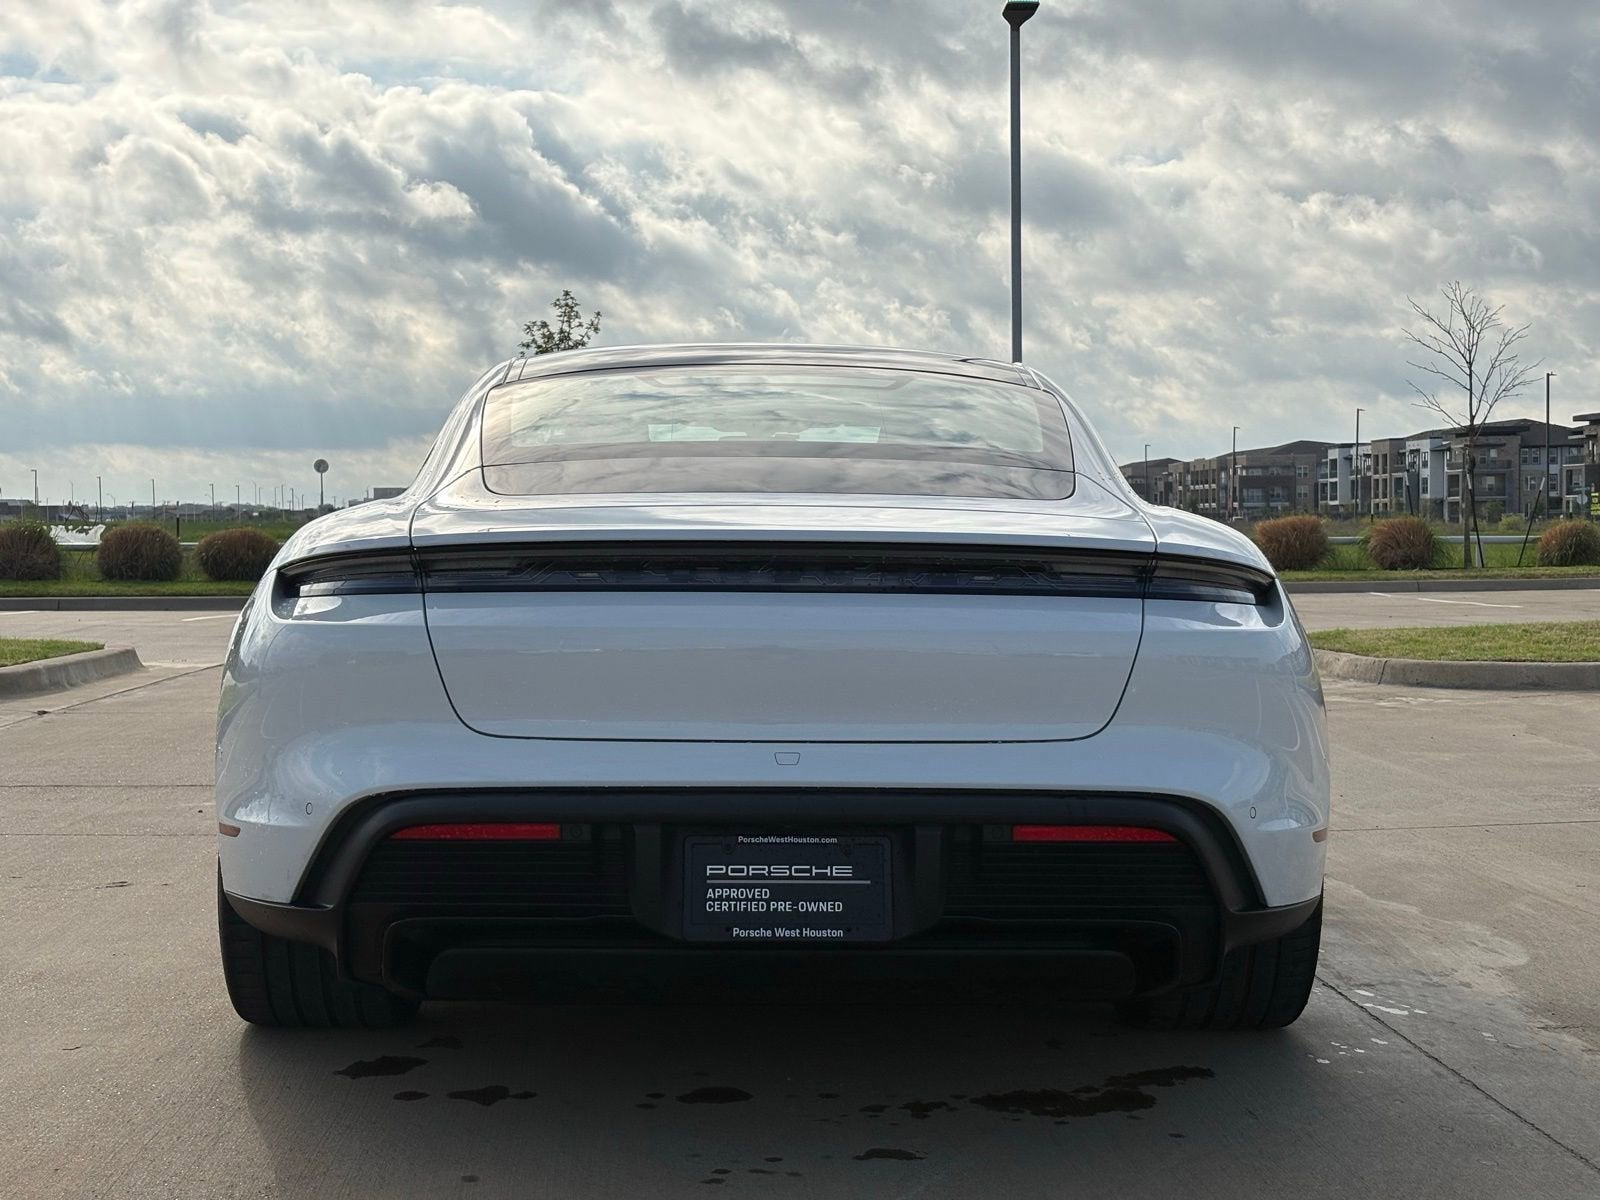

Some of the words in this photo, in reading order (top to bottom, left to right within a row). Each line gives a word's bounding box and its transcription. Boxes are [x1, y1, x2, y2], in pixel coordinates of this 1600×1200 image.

[738, 835, 838, 844] PorscheWestHouston.com
[706, 865, 853, 877] PORSCHE
[706, 888, 770, 899] APPROVED
[706, 901, 767, 912] CERTIFIED
[770, 901, 843, 912] PRE-OWNED
[732, 927, 772, 938] Porsche
[774, 927, 800, 938] West
[802, 927, 844, 938] Houston
